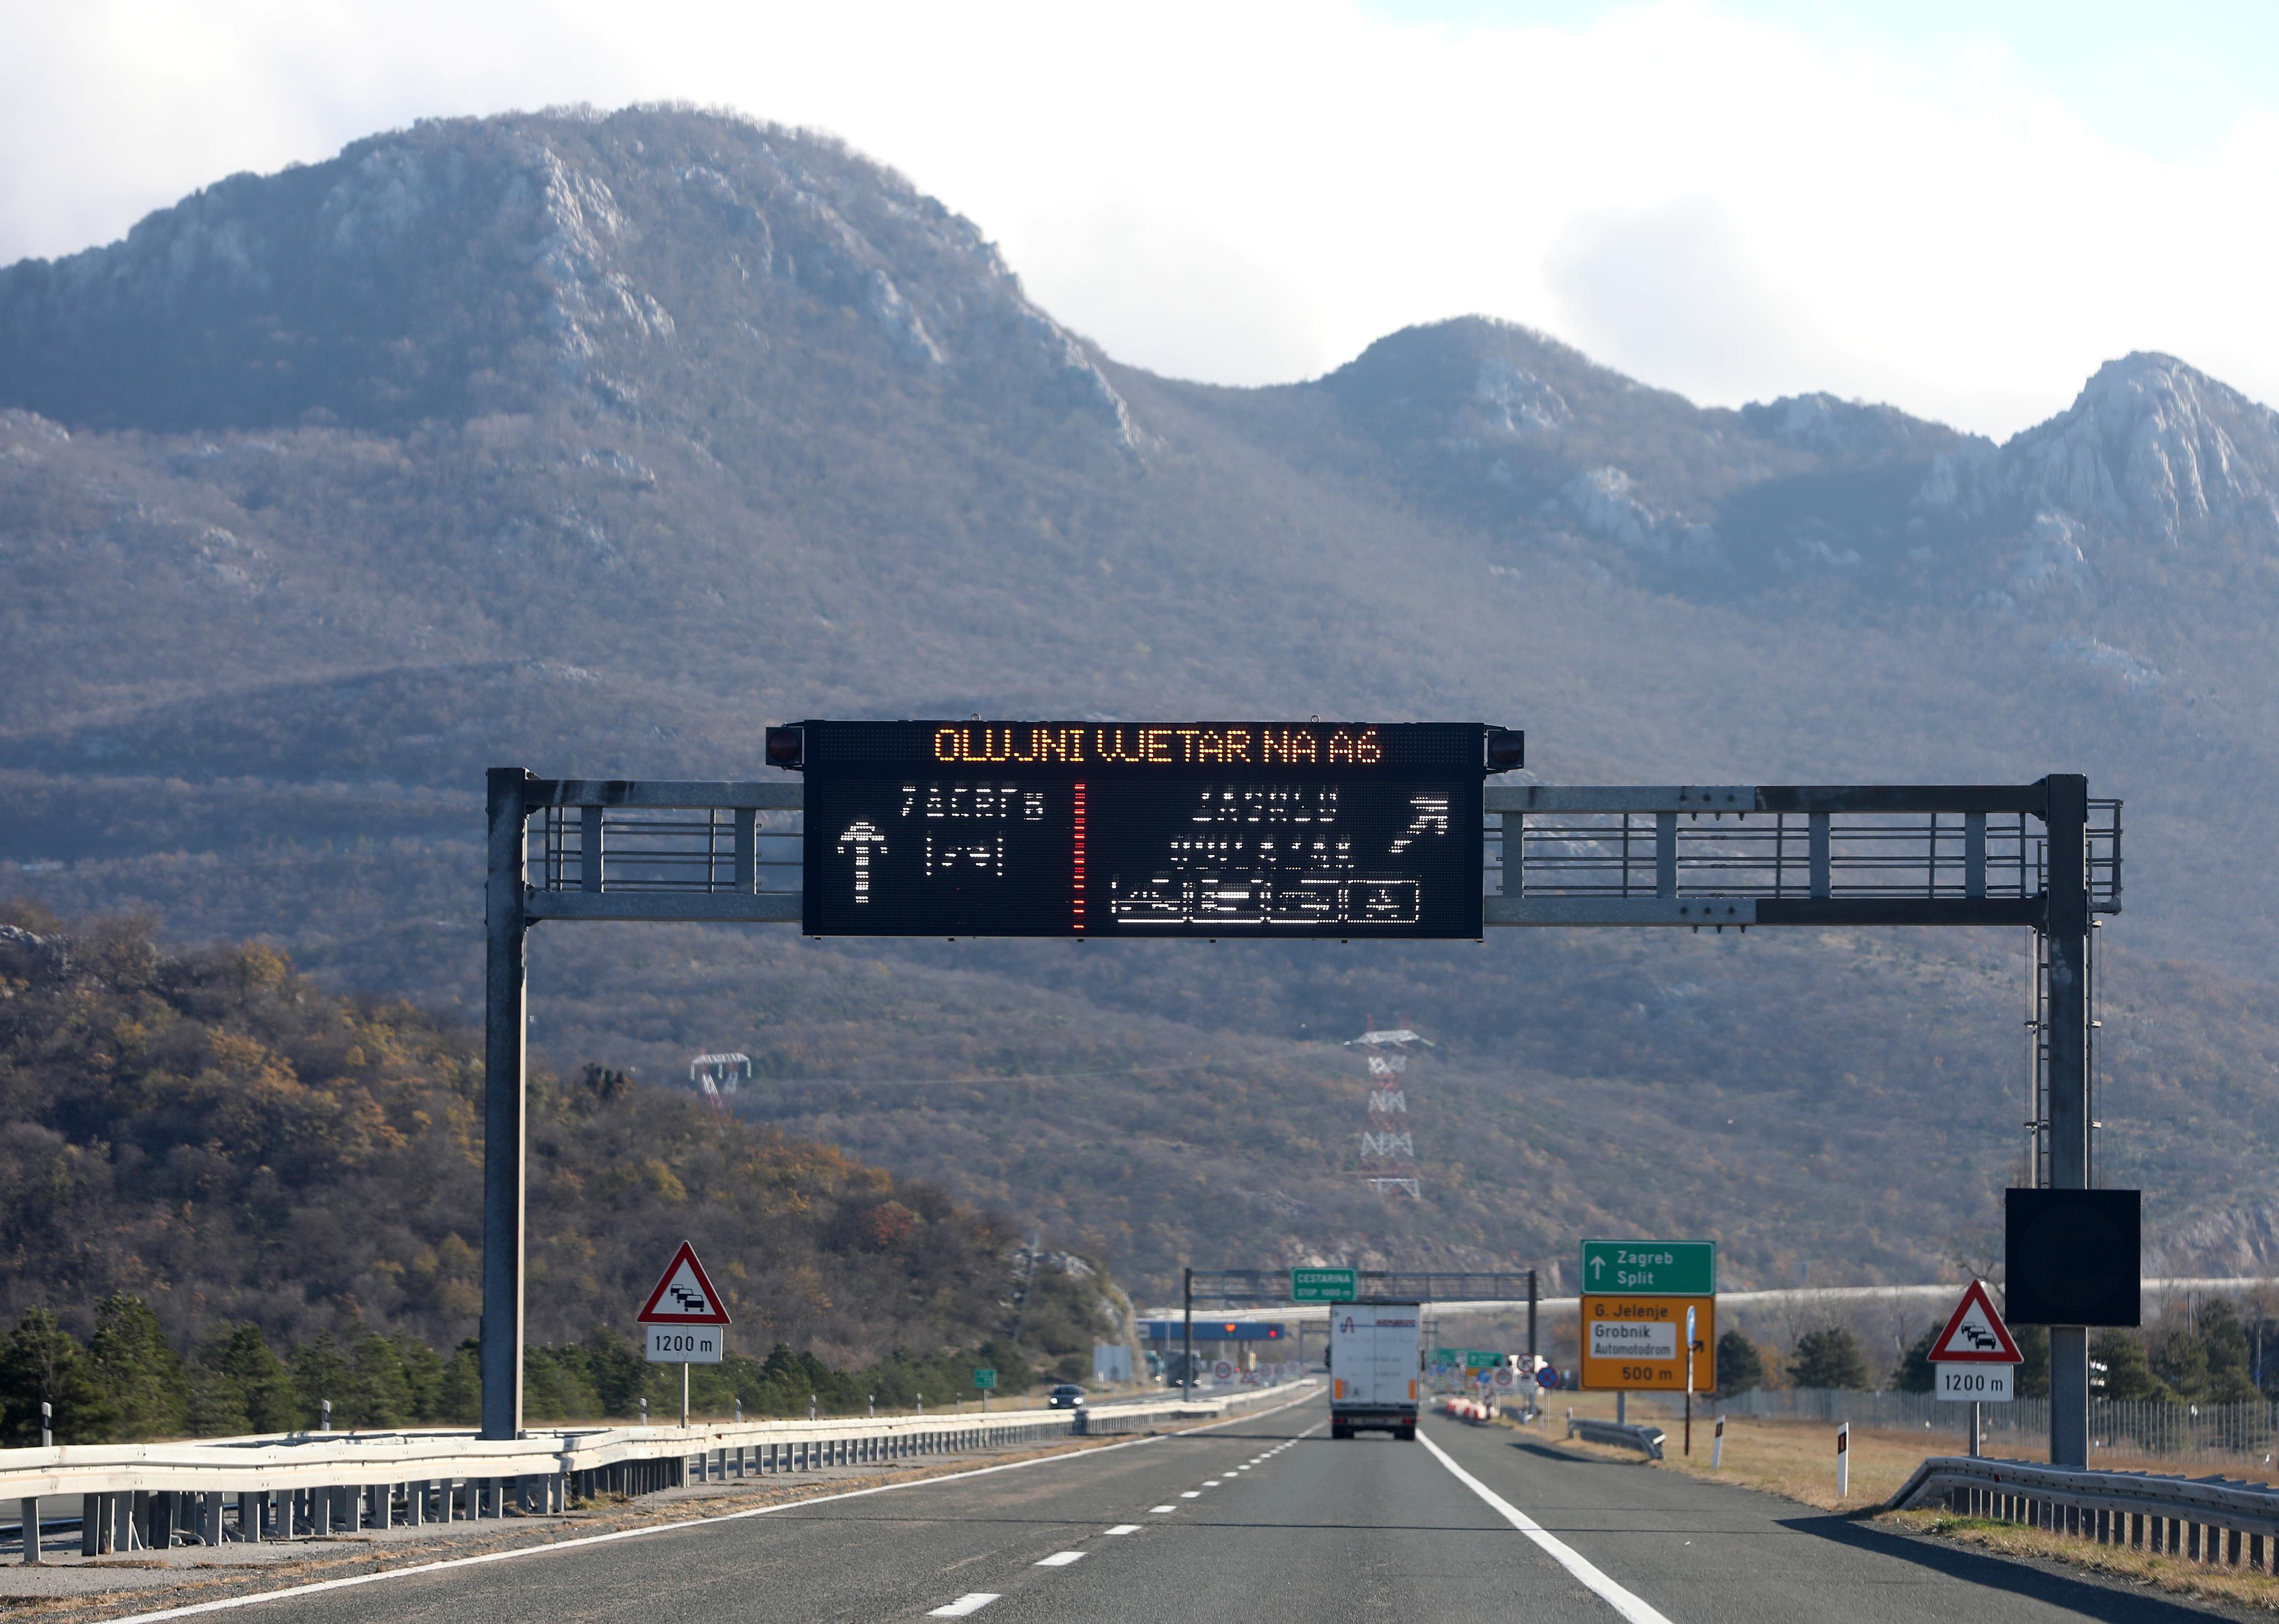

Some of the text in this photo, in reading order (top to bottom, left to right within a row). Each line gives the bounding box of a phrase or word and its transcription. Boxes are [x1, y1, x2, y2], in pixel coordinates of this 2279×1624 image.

[935, 729, 1381, 763] OLUJNI VJETAR NA A6
[1618, 1250, 1673, 1267] Zagreb
[1297, 1274, 1351, 1283] CESTARINA
[1618, 1271, 1653, 1287] Split
[1596, 1304, 1668, 1320] G. Jelenje
[1595, 1324, 1650, 1337] Grobnik
[656, 1335, 712, 1352] 1200 m
[1595, 1342, 1671, 1355] Automotodrom
[1623, 1367, 1672, 1380] 500 m
[1946, 1375, 2003, 1391] 1200 m
